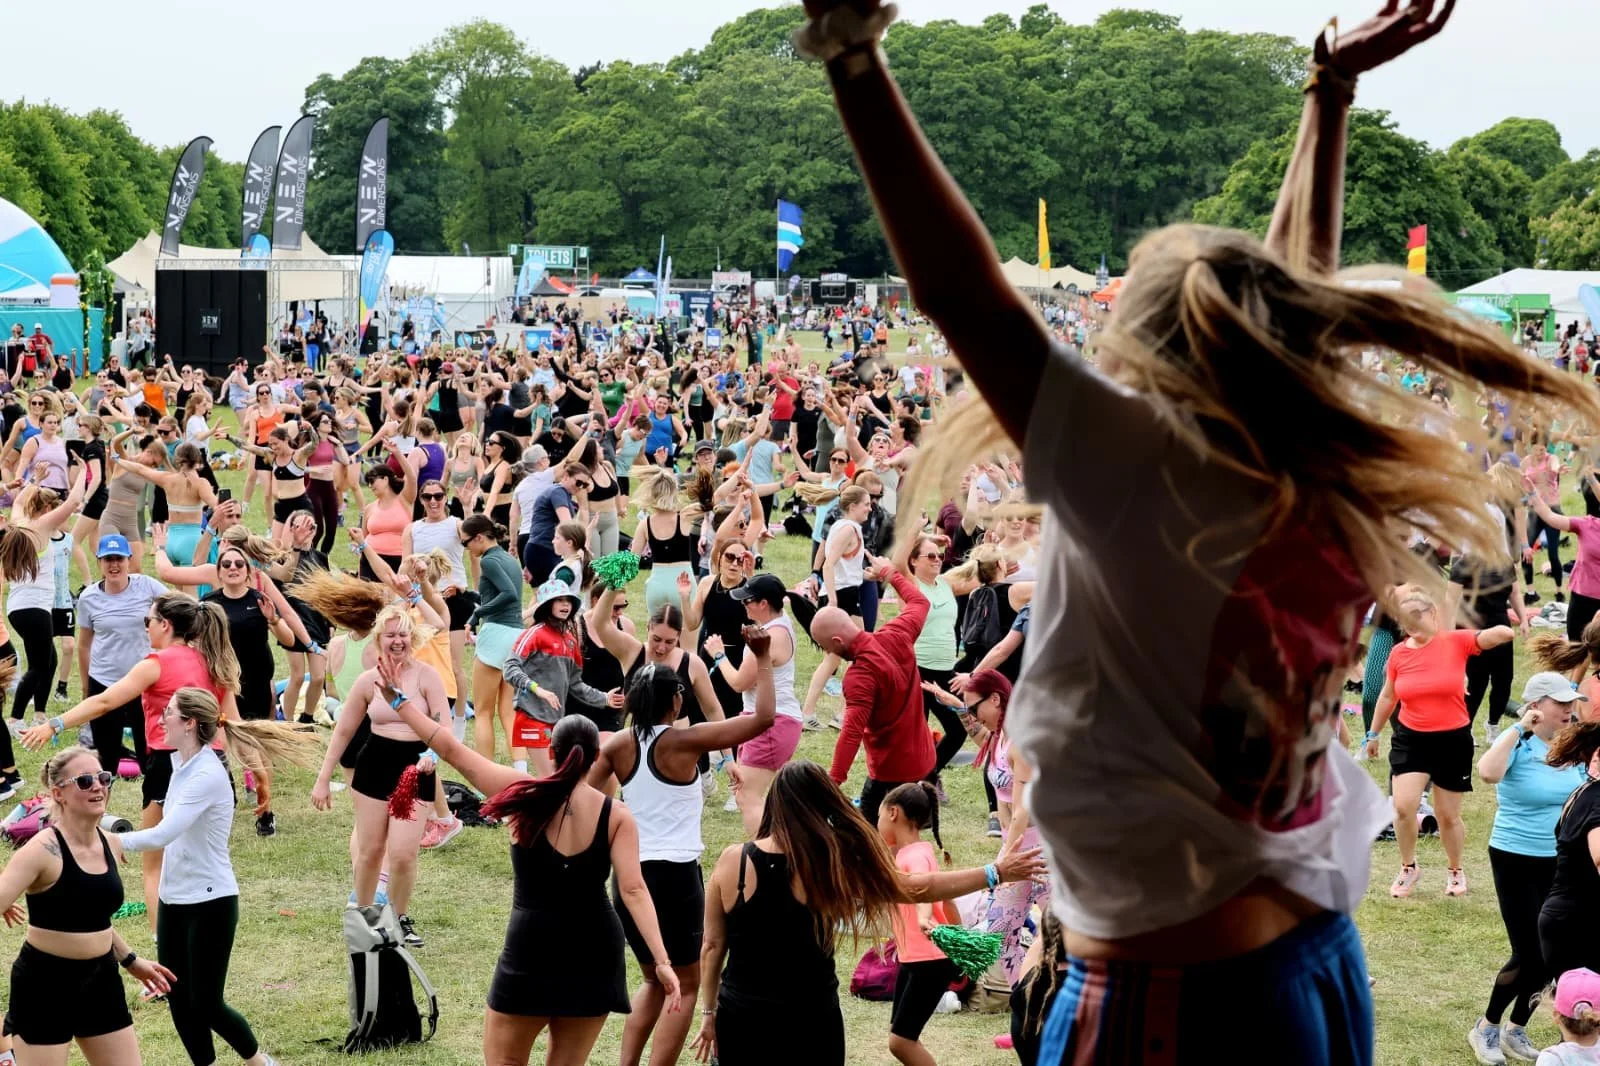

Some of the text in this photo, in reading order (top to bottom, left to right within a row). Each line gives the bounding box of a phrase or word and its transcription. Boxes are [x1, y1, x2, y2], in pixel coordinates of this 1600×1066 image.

[178, 171, 199, 221] ENSIONS
[243, 161, 264, 229] NEW
[255, 164, 274, 229] MENSIONS
[276, 151, 298, 223] NEW
[294, 155, 308, 225] DIMENSIONS
[360, 155, 377, 224] NEW
[376, 157, 386, 226] DIMENSIONS
[66, 611, 73, 625] 7
